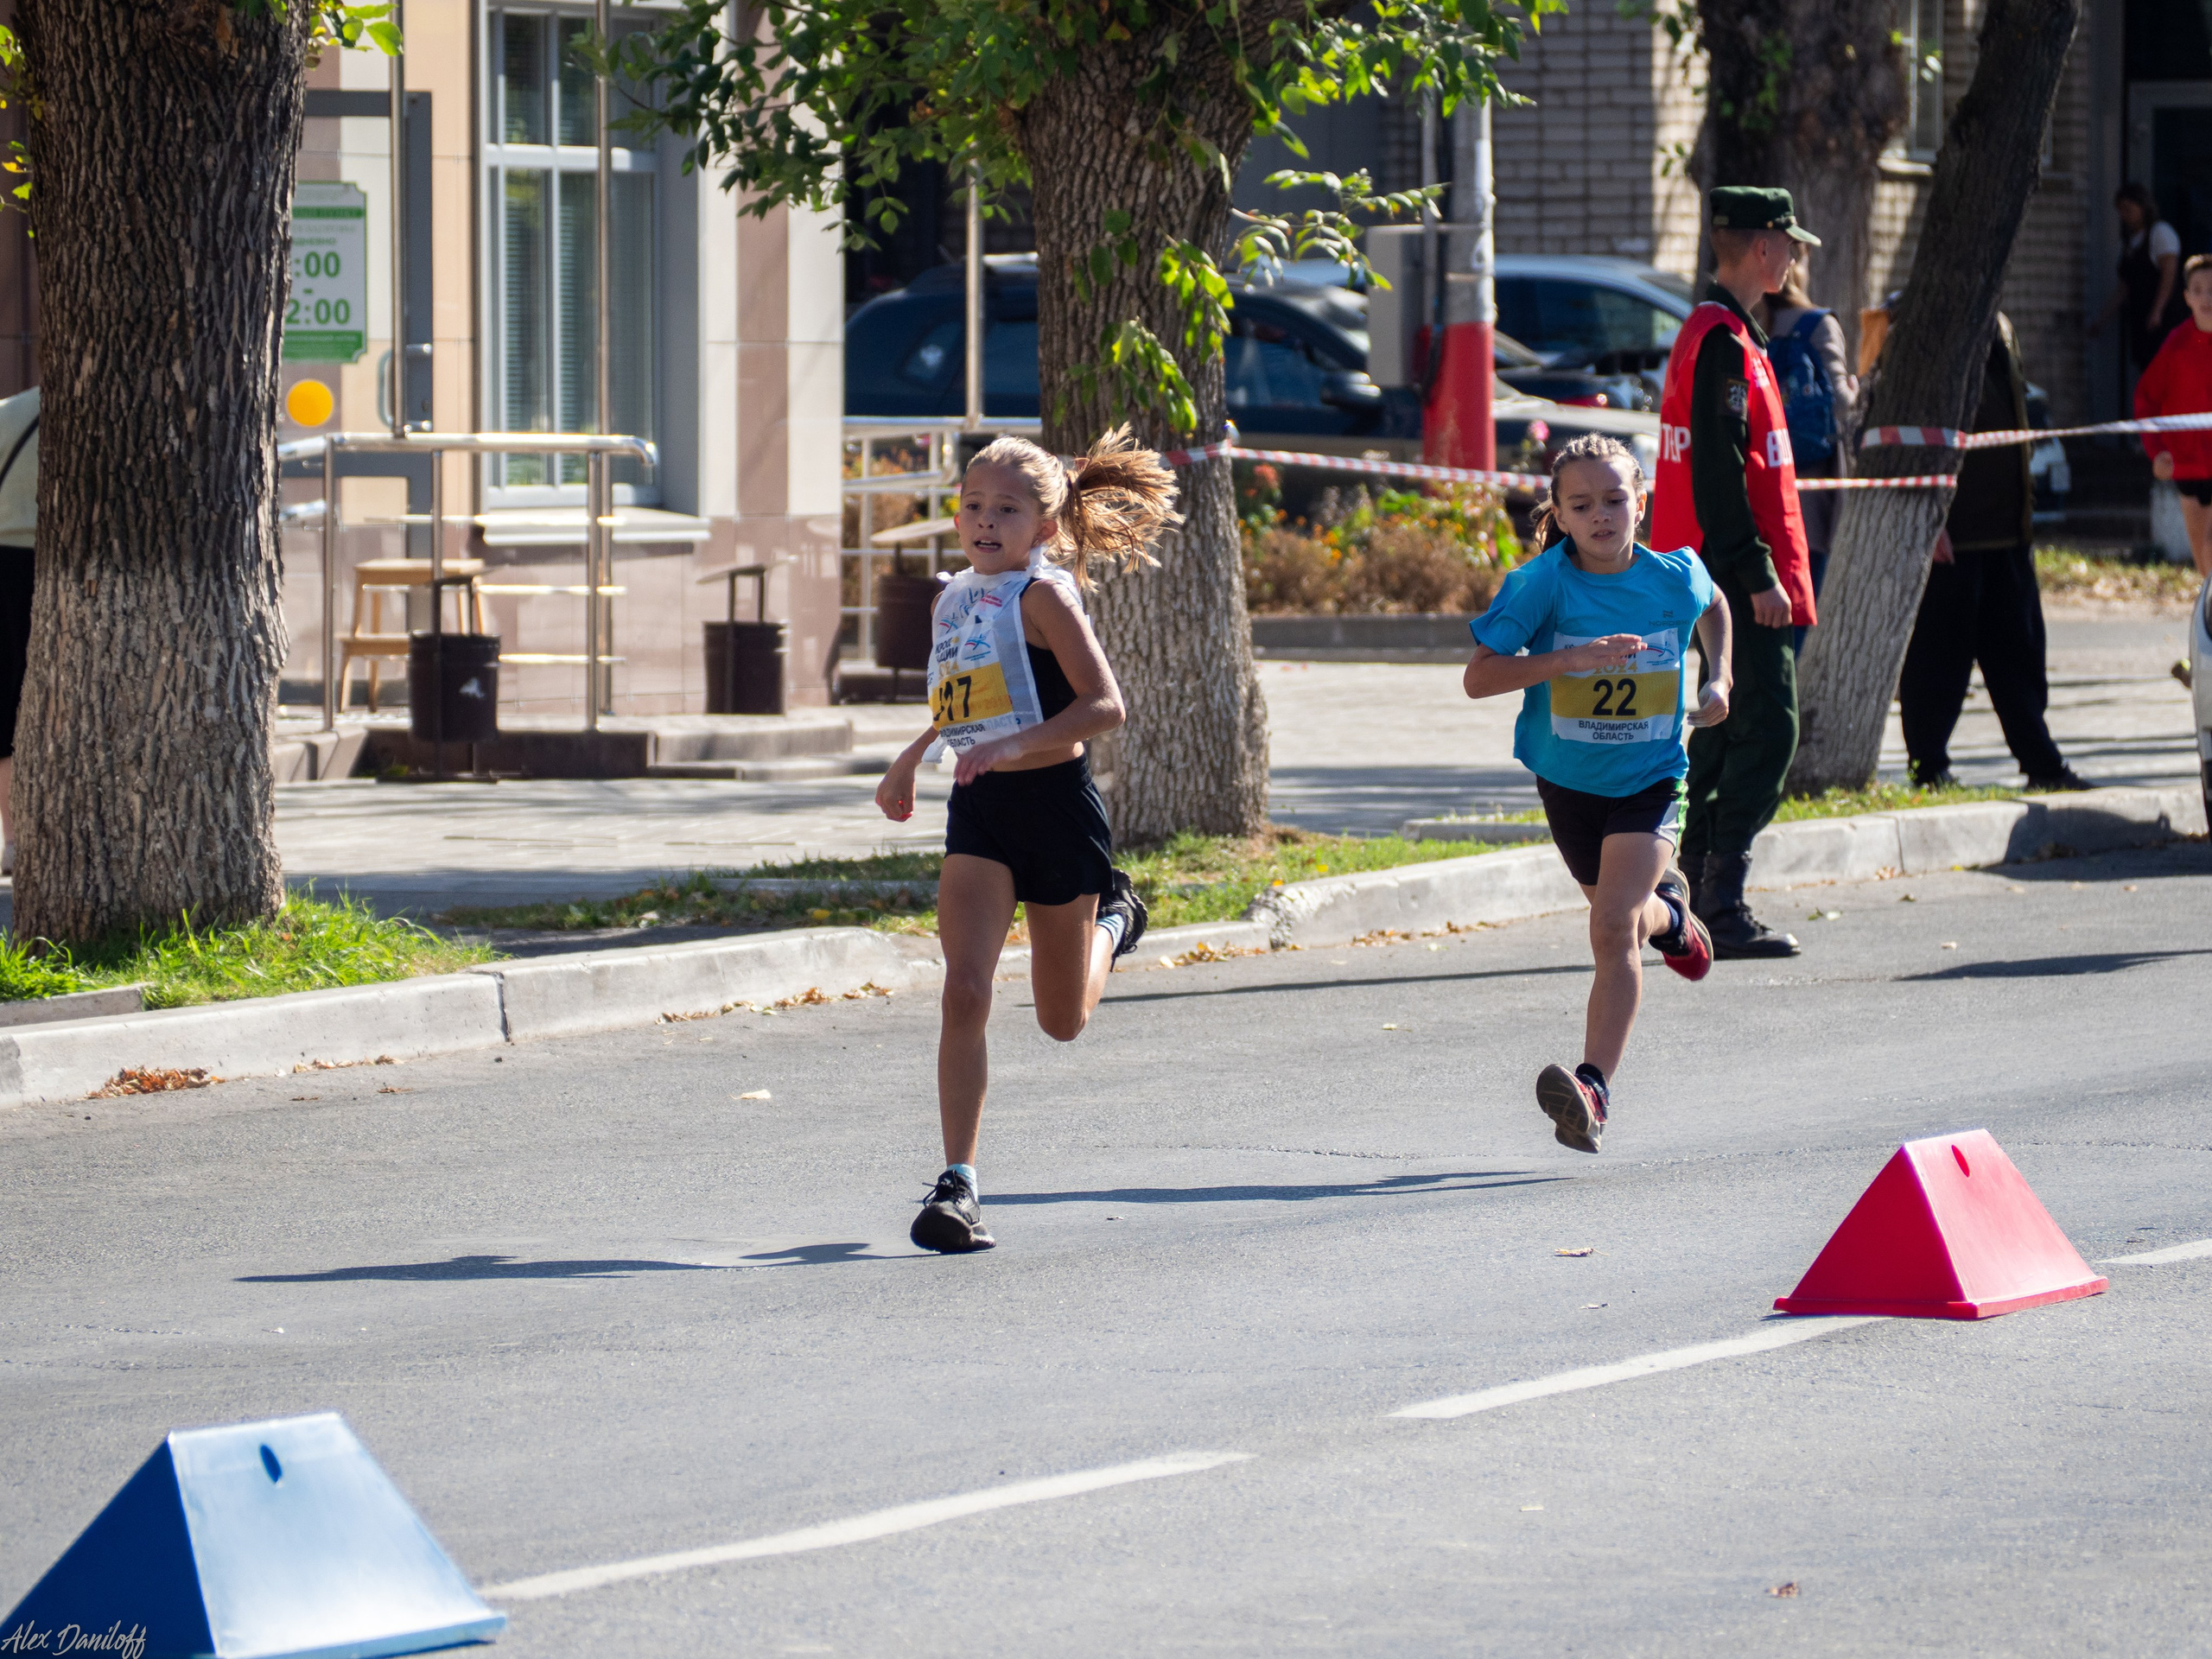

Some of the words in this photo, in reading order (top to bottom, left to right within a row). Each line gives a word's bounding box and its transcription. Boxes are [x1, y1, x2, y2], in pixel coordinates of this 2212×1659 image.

[295, 251, 340, 277] :00
[285, 299, 350, 325] 2:00
[1592, 677, 1637, 716] 22
[1579, 720, 1649, 731] ВЛАДИМИРСКАЯ
[1592, 732, 1634, 741] ОБЛАСТЬ
